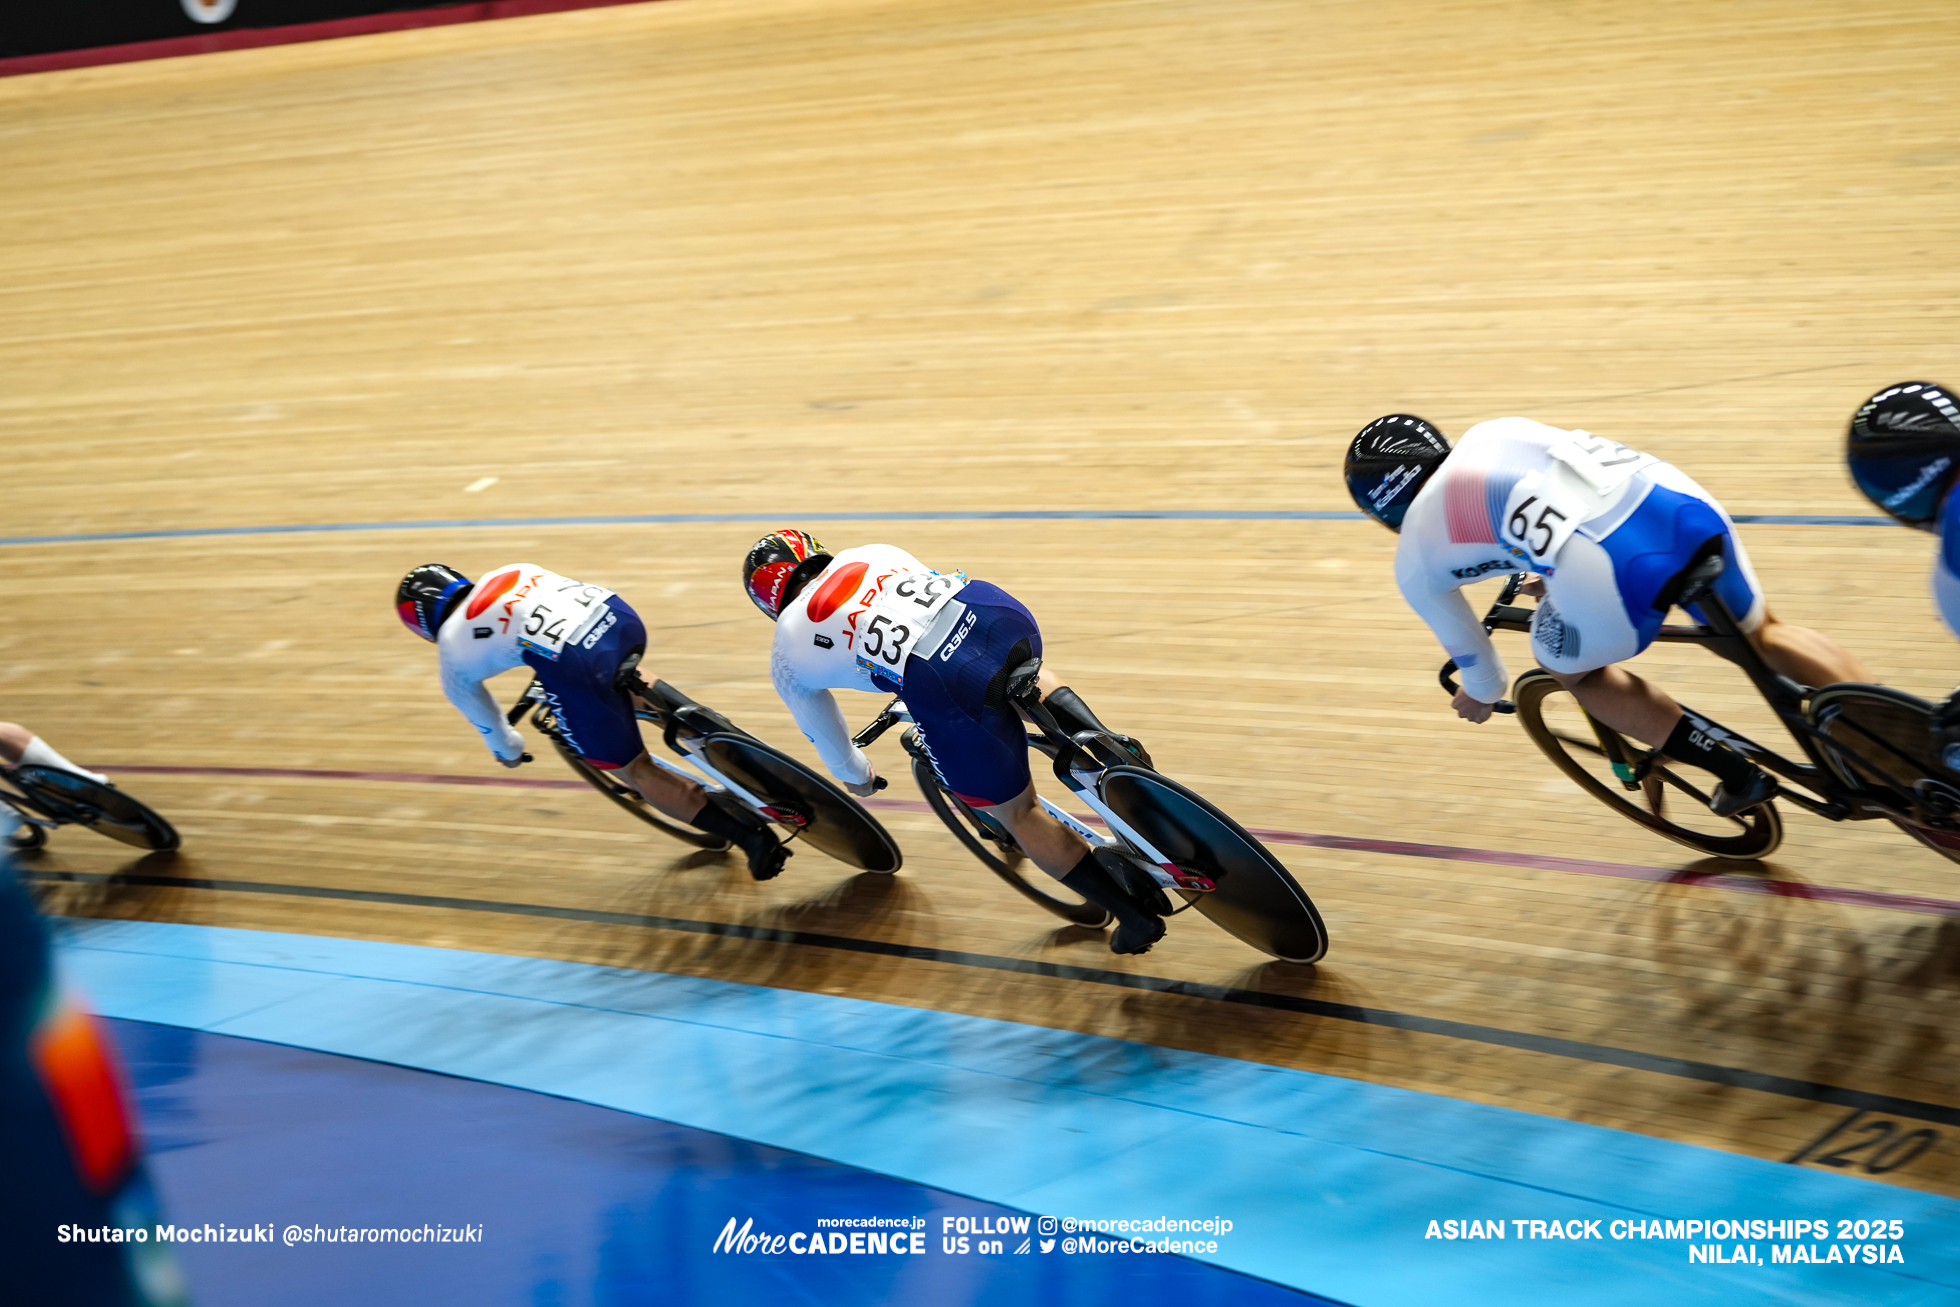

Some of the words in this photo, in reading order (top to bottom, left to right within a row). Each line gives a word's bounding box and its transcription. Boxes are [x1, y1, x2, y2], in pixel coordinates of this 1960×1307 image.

[1508, 495, 1570, 557] 65
[768, 566, 797, 611] JAPAN
[524, 604, 568, 646] 54
[863, 614, 910, 666] 53
[939, 610, 977, 662] Q36.5
